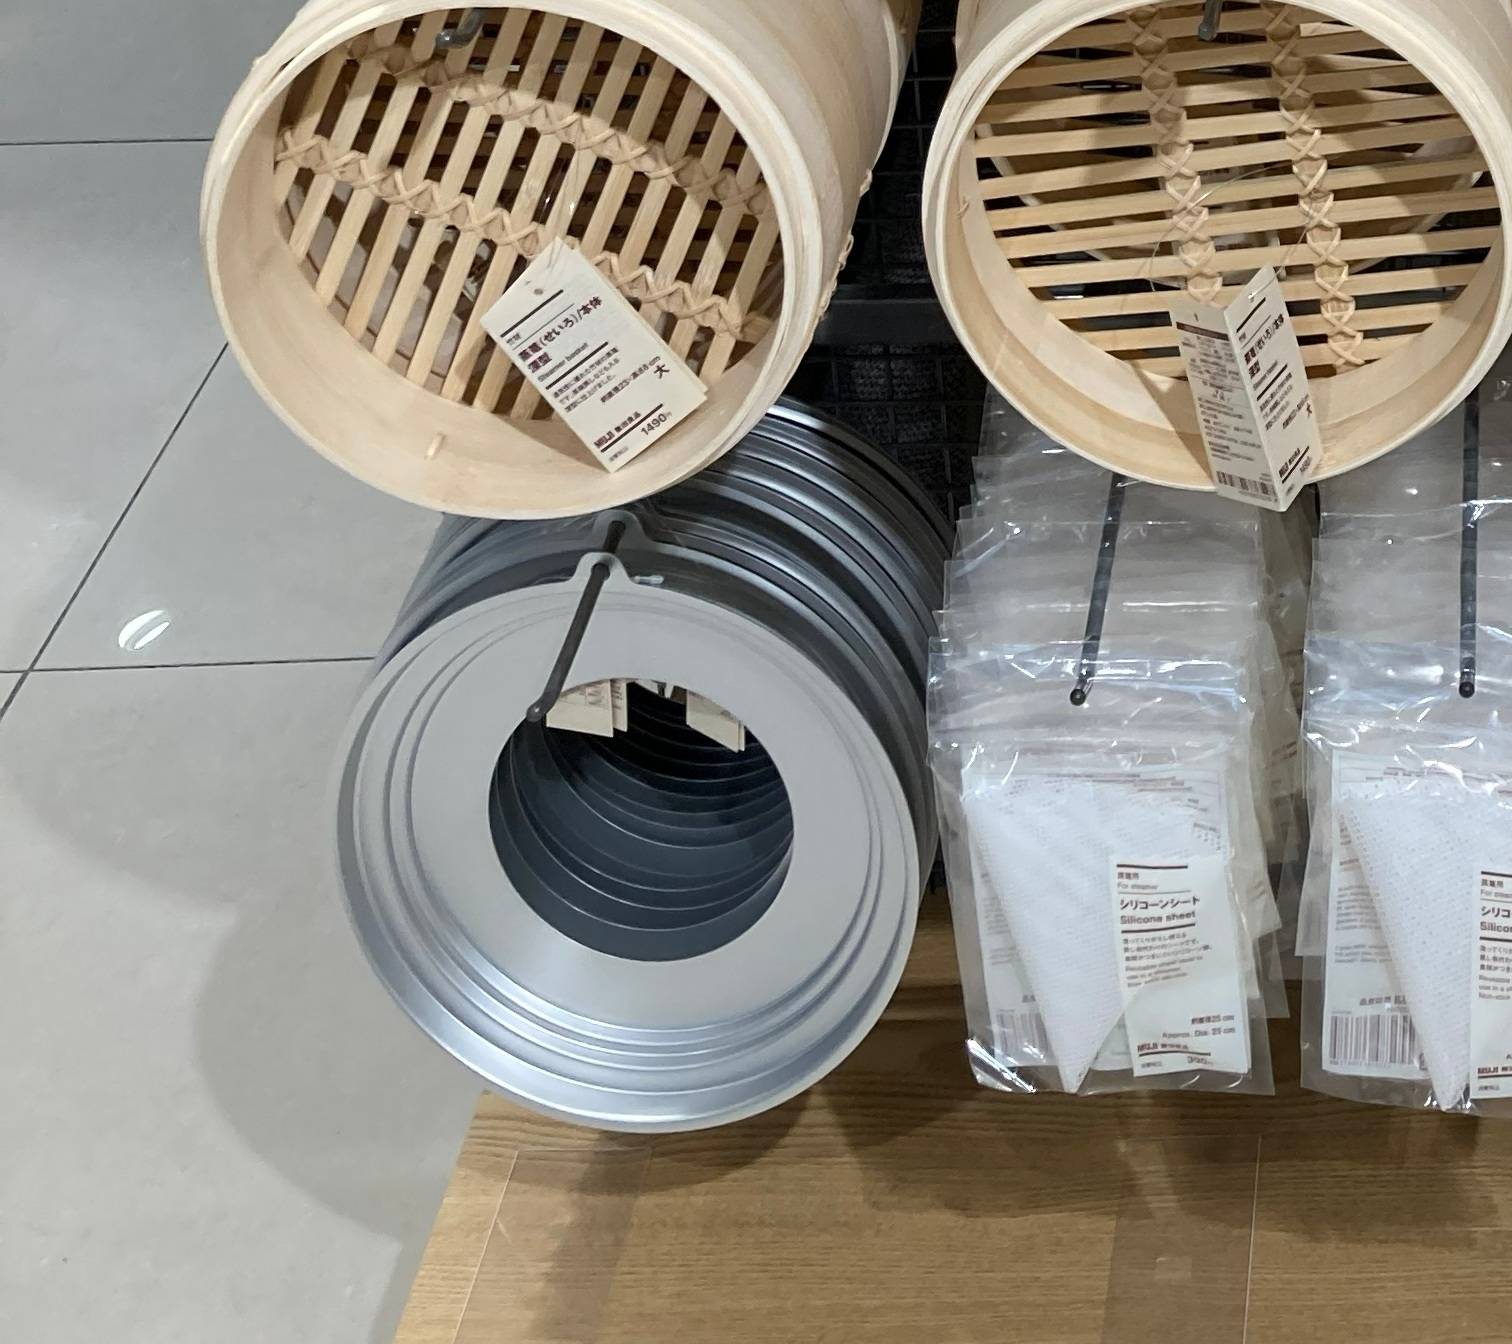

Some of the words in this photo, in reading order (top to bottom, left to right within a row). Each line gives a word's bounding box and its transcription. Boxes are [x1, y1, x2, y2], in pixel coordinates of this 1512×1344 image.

[654, 363, 670, 379] 大
[1120, 895, 1200, 911] シリコーンシート
[1120, 913, 1163, 925] Silicone
[1165, 911, 1196, 923] sheet
